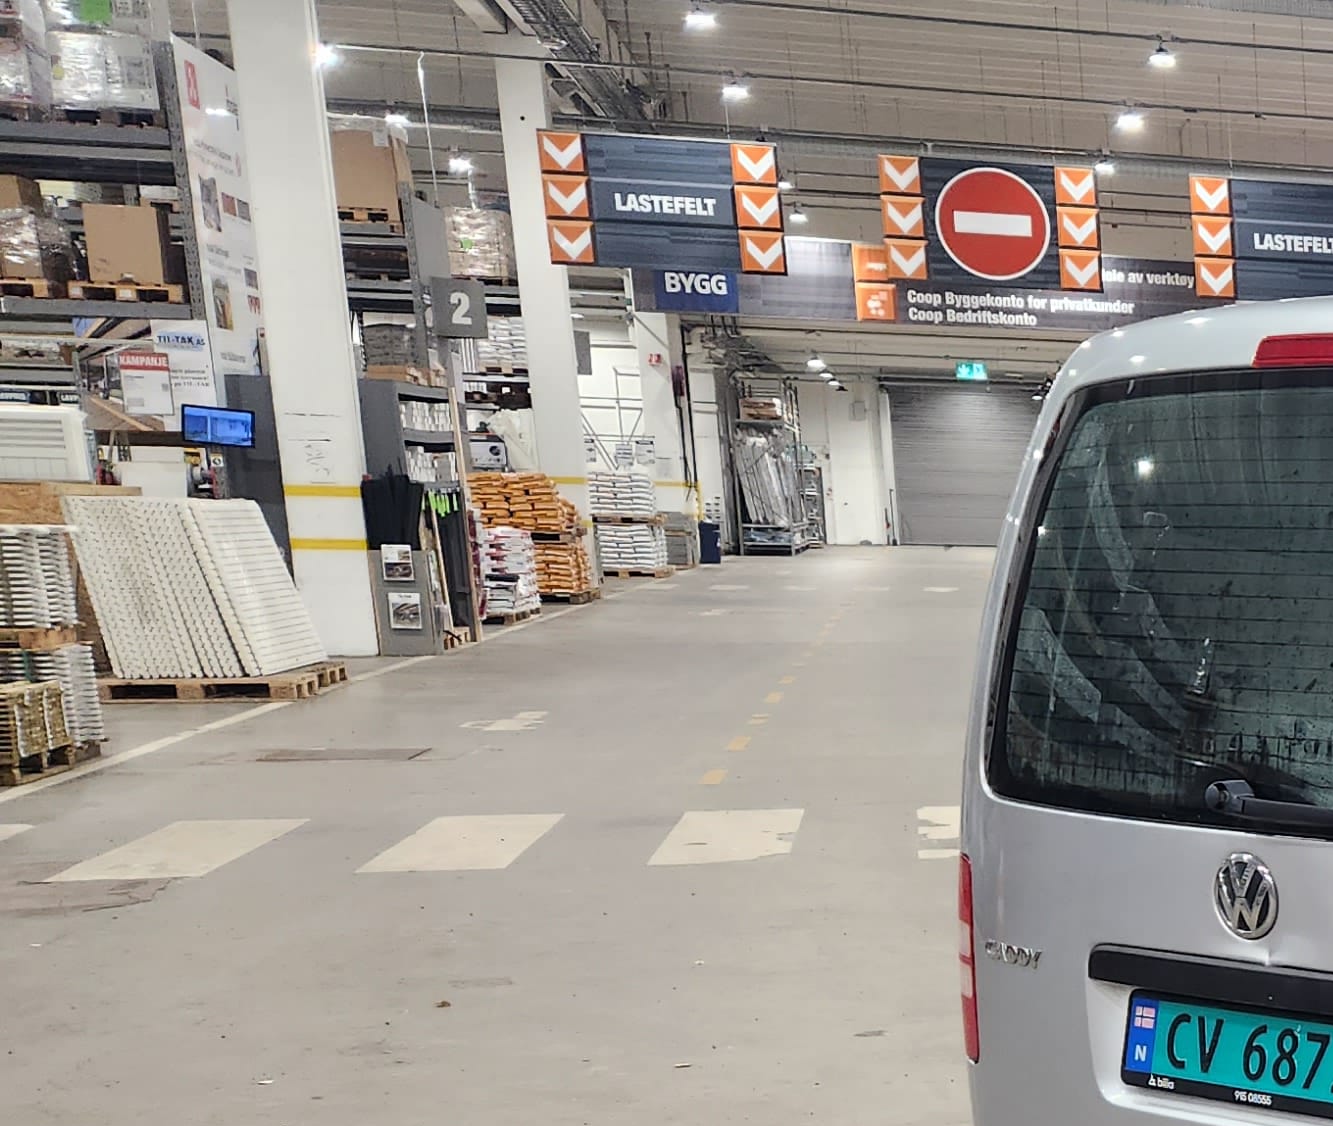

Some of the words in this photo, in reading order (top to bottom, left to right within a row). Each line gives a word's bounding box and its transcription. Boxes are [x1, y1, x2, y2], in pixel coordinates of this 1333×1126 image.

[614, 193, 717, 217] LASTEFELT
[664, 272, 728, 295] BYGG
[1128, 272, 1144, 284] av
[1146, 272, 1195, 289] verktøy
[450, 292, 472, 325] 2
[907, 290, 942, 307] Coop
[944, 291, 1025, 310] Byggekonto
[1027, 295, 1048, 310] for
[1050, 296, 1135, 315] privatkunder
[908, 307, 943, 325] Coop
[946, 309, 1038, 327] Bedriftskonto
[120, 354, 169, 367] KAMPANJE
[1134, 1045, 1147, 1061] N
[1166, 1013, 1225, 1074] CV
